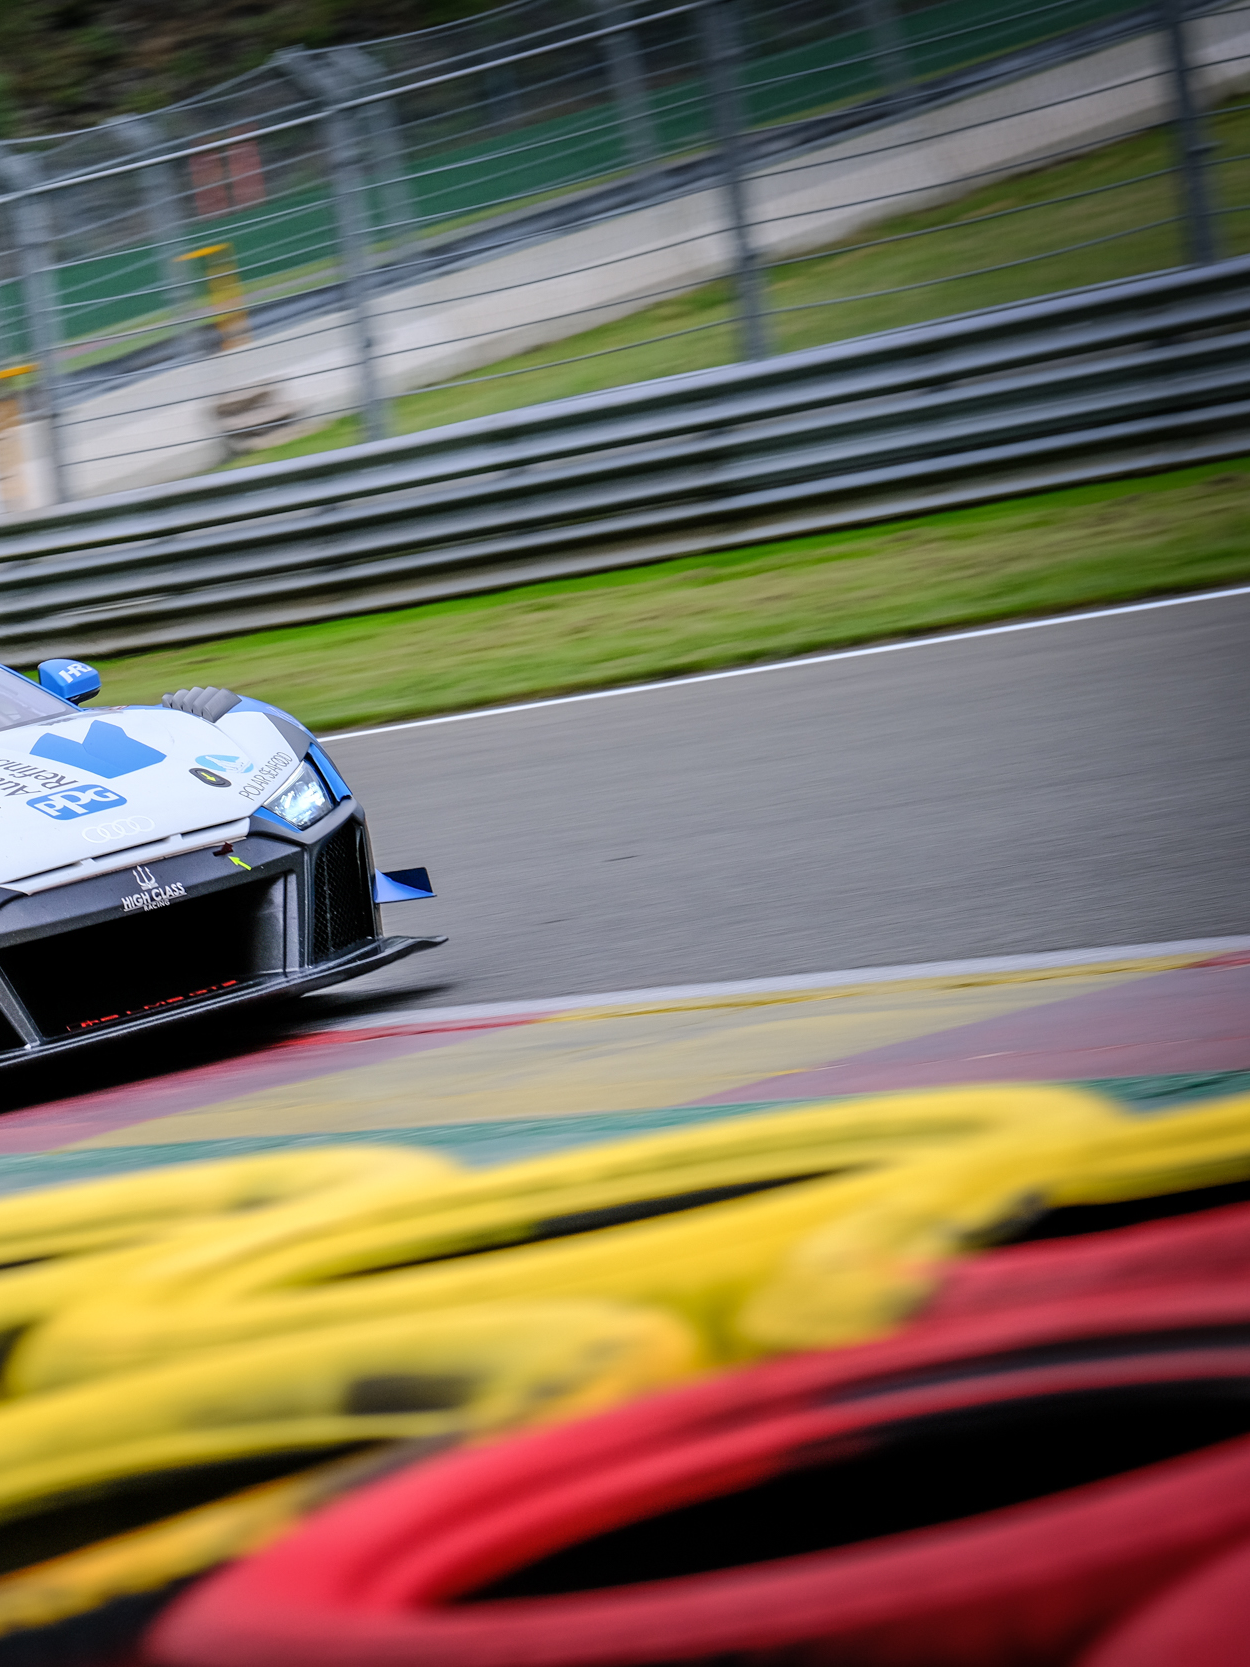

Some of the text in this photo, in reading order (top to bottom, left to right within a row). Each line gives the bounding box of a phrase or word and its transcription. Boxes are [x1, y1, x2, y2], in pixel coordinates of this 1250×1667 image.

[34, 787, 120, 816] PPG
[121, 881, 187, 911] HIGH CLASS
[143, 900, 170, 912] RACING
